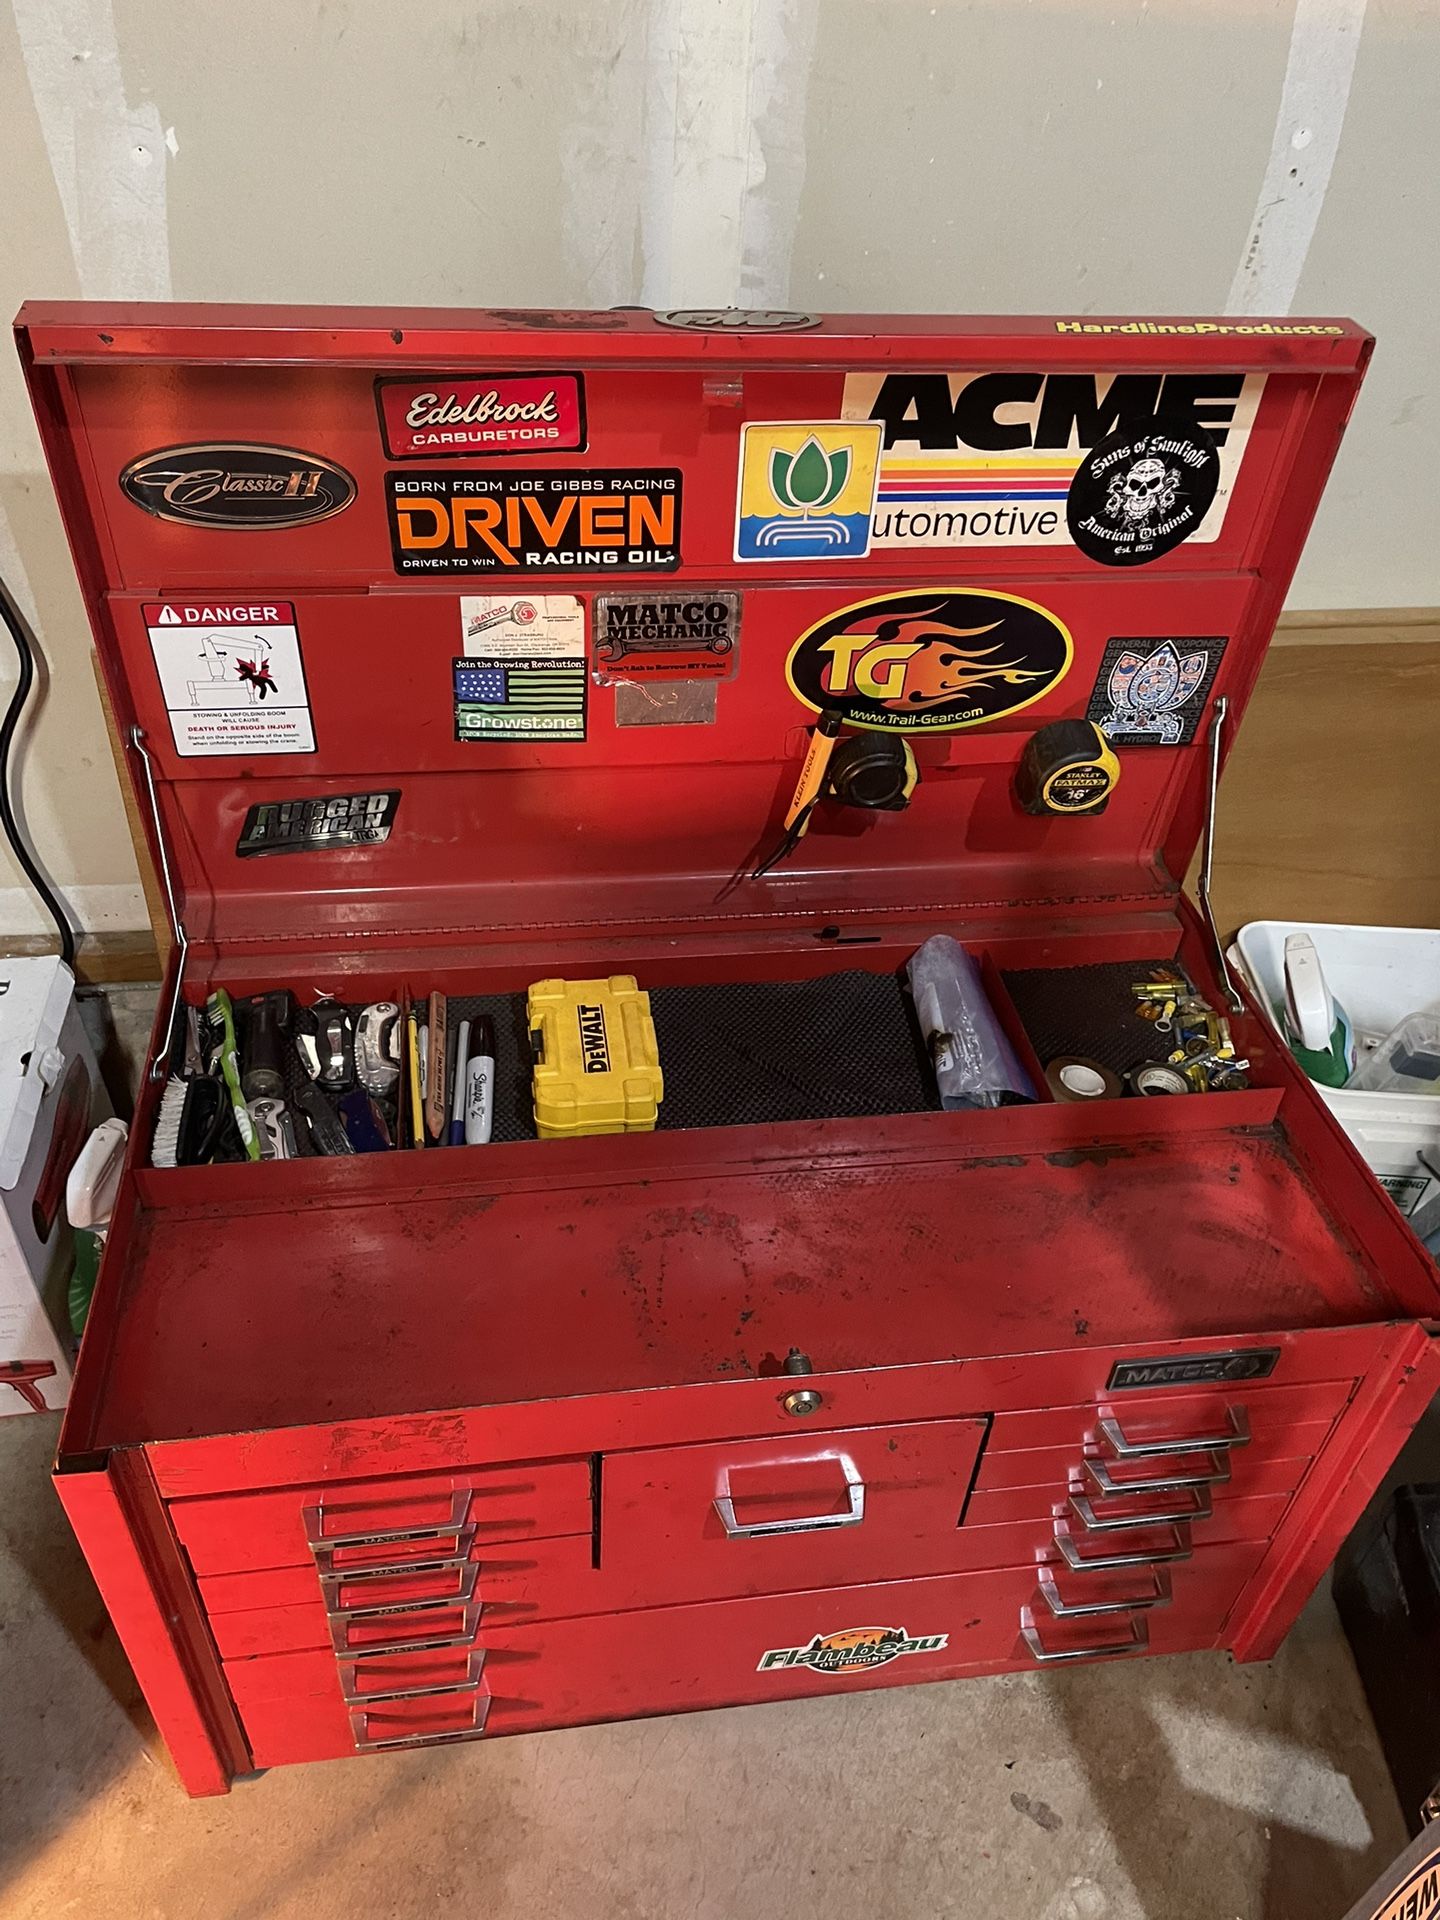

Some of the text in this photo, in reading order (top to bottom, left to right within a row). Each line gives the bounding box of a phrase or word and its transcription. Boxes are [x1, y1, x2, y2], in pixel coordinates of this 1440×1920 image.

[1056, 321, 1345, 336] HardlineProducts
[405, 390, 558, 429] Edelbrock
[869, 372, 1246, 452] ACME
[412, 427, 560, 446] CARBURETORS
[134, 469, 284, 506] Classic
[394, 479, 676, 493] BORN FROM JOE GIBBS RACING
[395, 494, 676, 565] DRIVEN
[871, 505, 1058, 539] utomotive
[1078, 515, 1135, 542] American
[403, 558, 496, 568] DRIVEN TO WIN
[526, 550, 670, 566] RACING OIL
[184, 606, 279, 622] DANGER
[606, 602, 729, 625] MATCO
[606, 623, 728, 640] MECHANIC
[1108, 640, 1151, 648] GENERAL
[493, 661, 530, 669] Growing
[531, 660, 585, 669] Revolution!
[817, 634, 925, 698] TG
[849, 707, 984, 726] www.Trail-Gear.com
[1056, 779, 1106, 787] FATMAX
[794, 779, 807, 808] KLEIN
[580, 1004, 608, 1073] DEWALT
[473, 1072, 487, 1105] Sharpie
[364, 1534, 411, 1545] MATCO
[371, 1566, 417, 1577] MATCO
[763, 1636, 943, 1669] Flambeau
[819, 1655, 887, 1668] OUTDOORS
